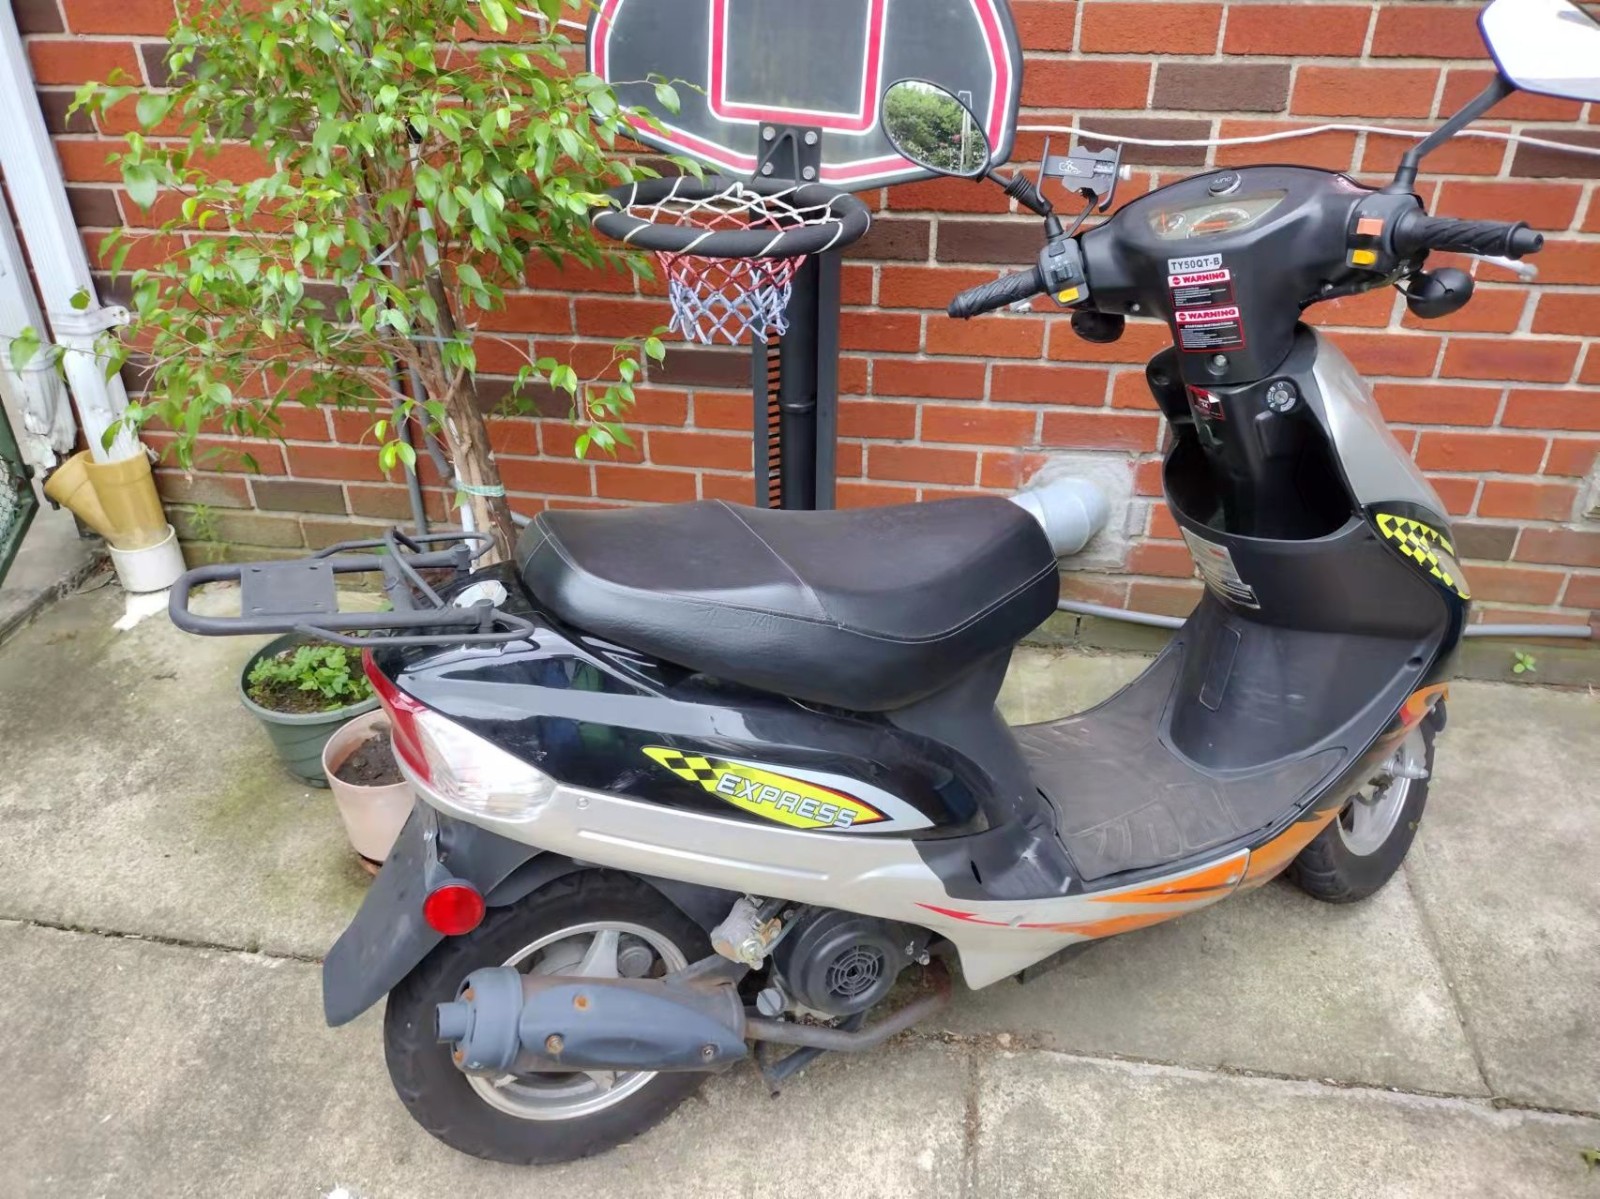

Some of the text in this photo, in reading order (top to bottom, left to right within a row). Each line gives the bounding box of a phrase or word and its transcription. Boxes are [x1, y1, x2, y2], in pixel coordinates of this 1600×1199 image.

[1171, 257, 1220, 270] TY50QT-B
[1182, 271, 1226, 283] WARNING
[1187, 308, 1236, 319] WARNING
[715, 772, 858, 829] EXPRESS
